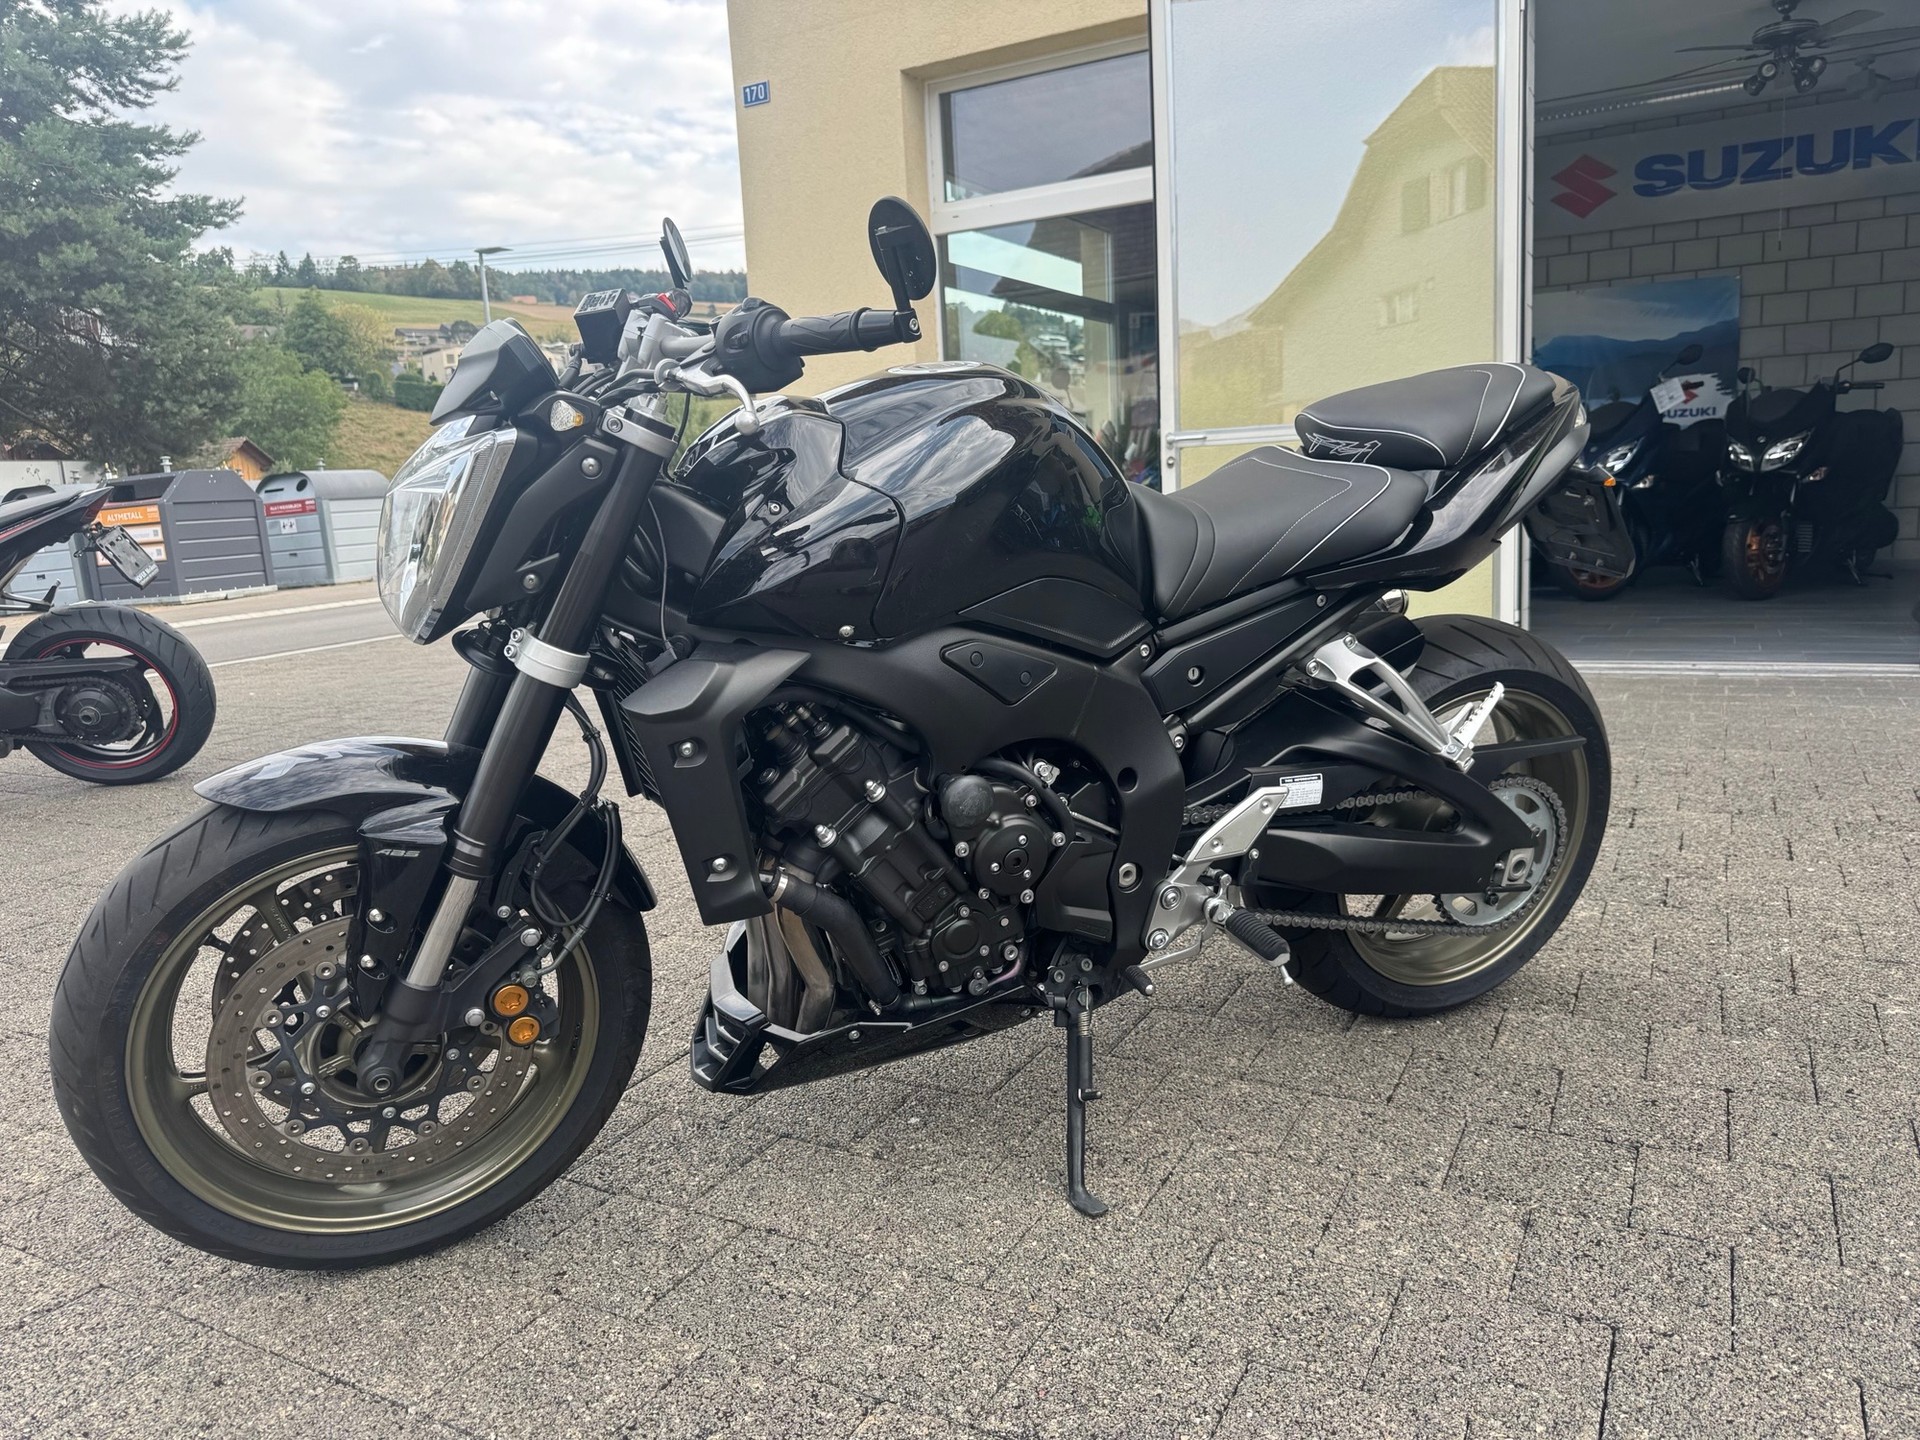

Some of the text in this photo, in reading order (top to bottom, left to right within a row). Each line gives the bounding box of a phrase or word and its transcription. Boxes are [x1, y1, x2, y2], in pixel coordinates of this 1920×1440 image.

[744, 84, 765, 102] 170
[1633, 118, 1920, 197] SUZUK
[1664, 406, 1717, 419] UZUKI
[107, 511, 144, 522] ALTMETALL
[375, 848, 421, 858] ABS
